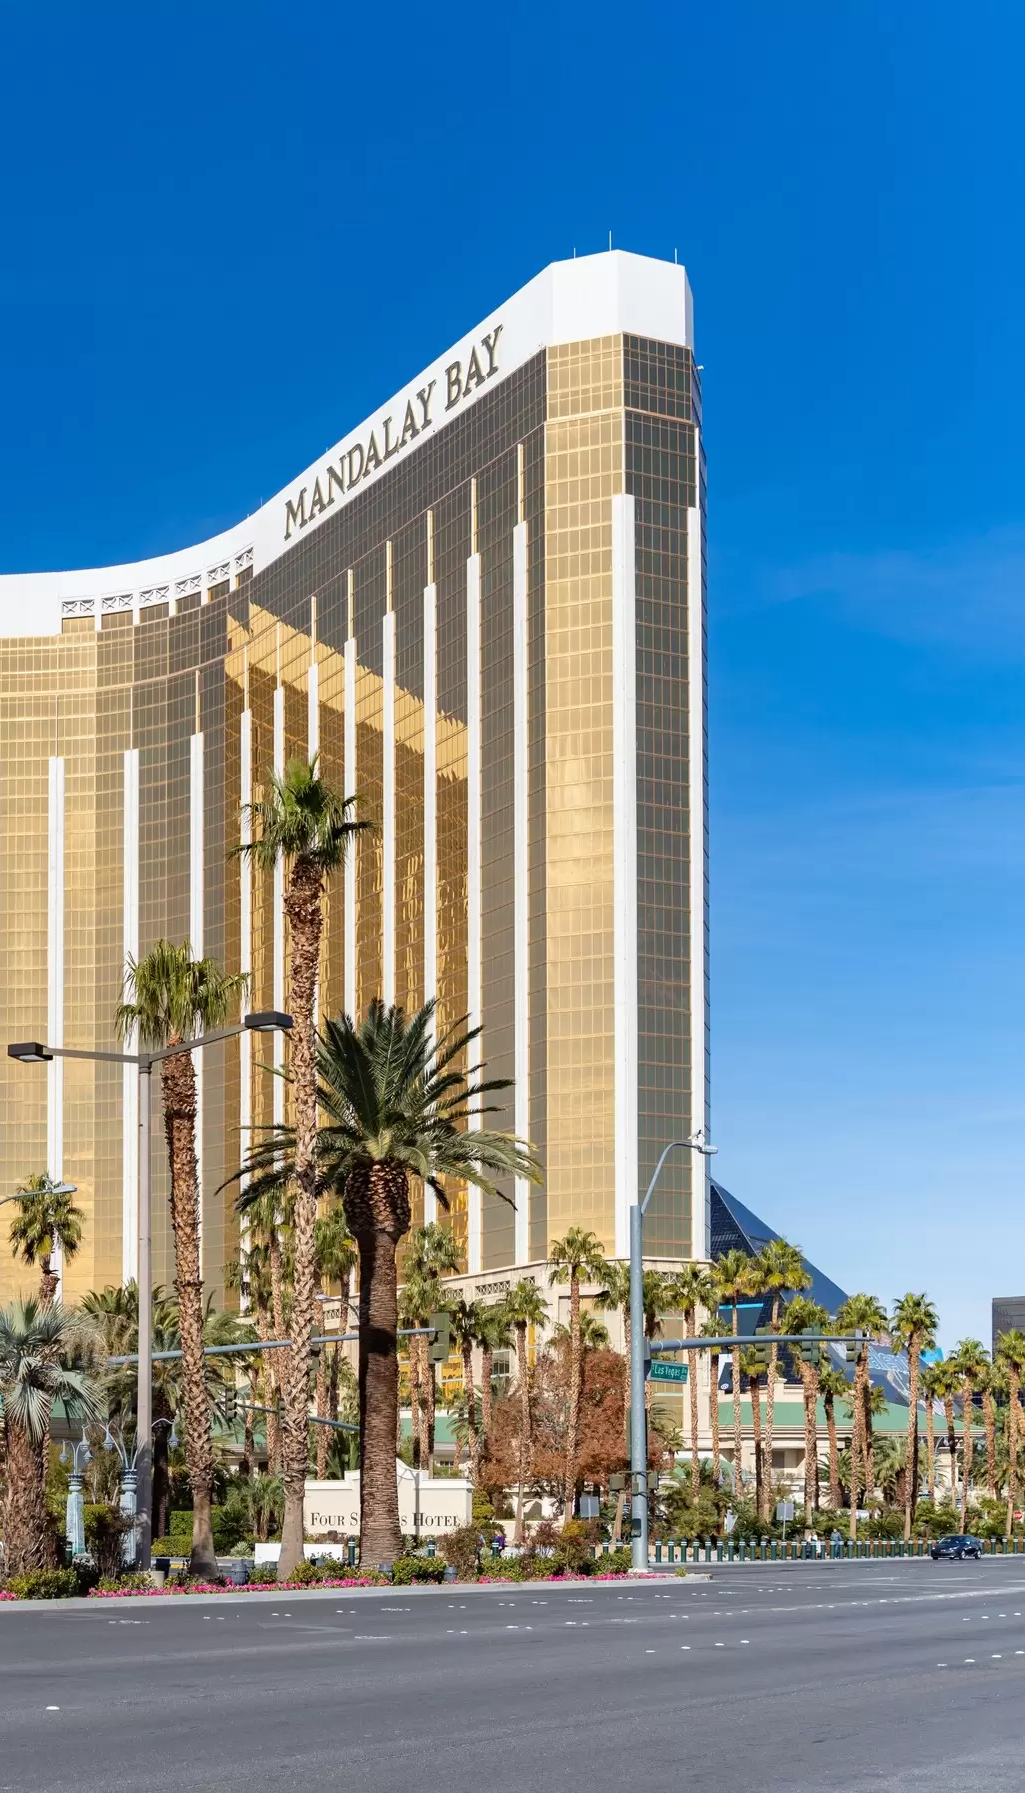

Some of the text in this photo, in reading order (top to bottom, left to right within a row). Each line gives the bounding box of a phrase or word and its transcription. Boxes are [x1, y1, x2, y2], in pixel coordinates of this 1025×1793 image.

[284, 324, 504, 541] MANDALAY BAY
[654, 1364, 664, 1375] Las
[665, 1366, 681, 1379] Vegas
[310, 1512, 345, 1527] FOUR
[412, 1512, 461, 1527] HOTEL
